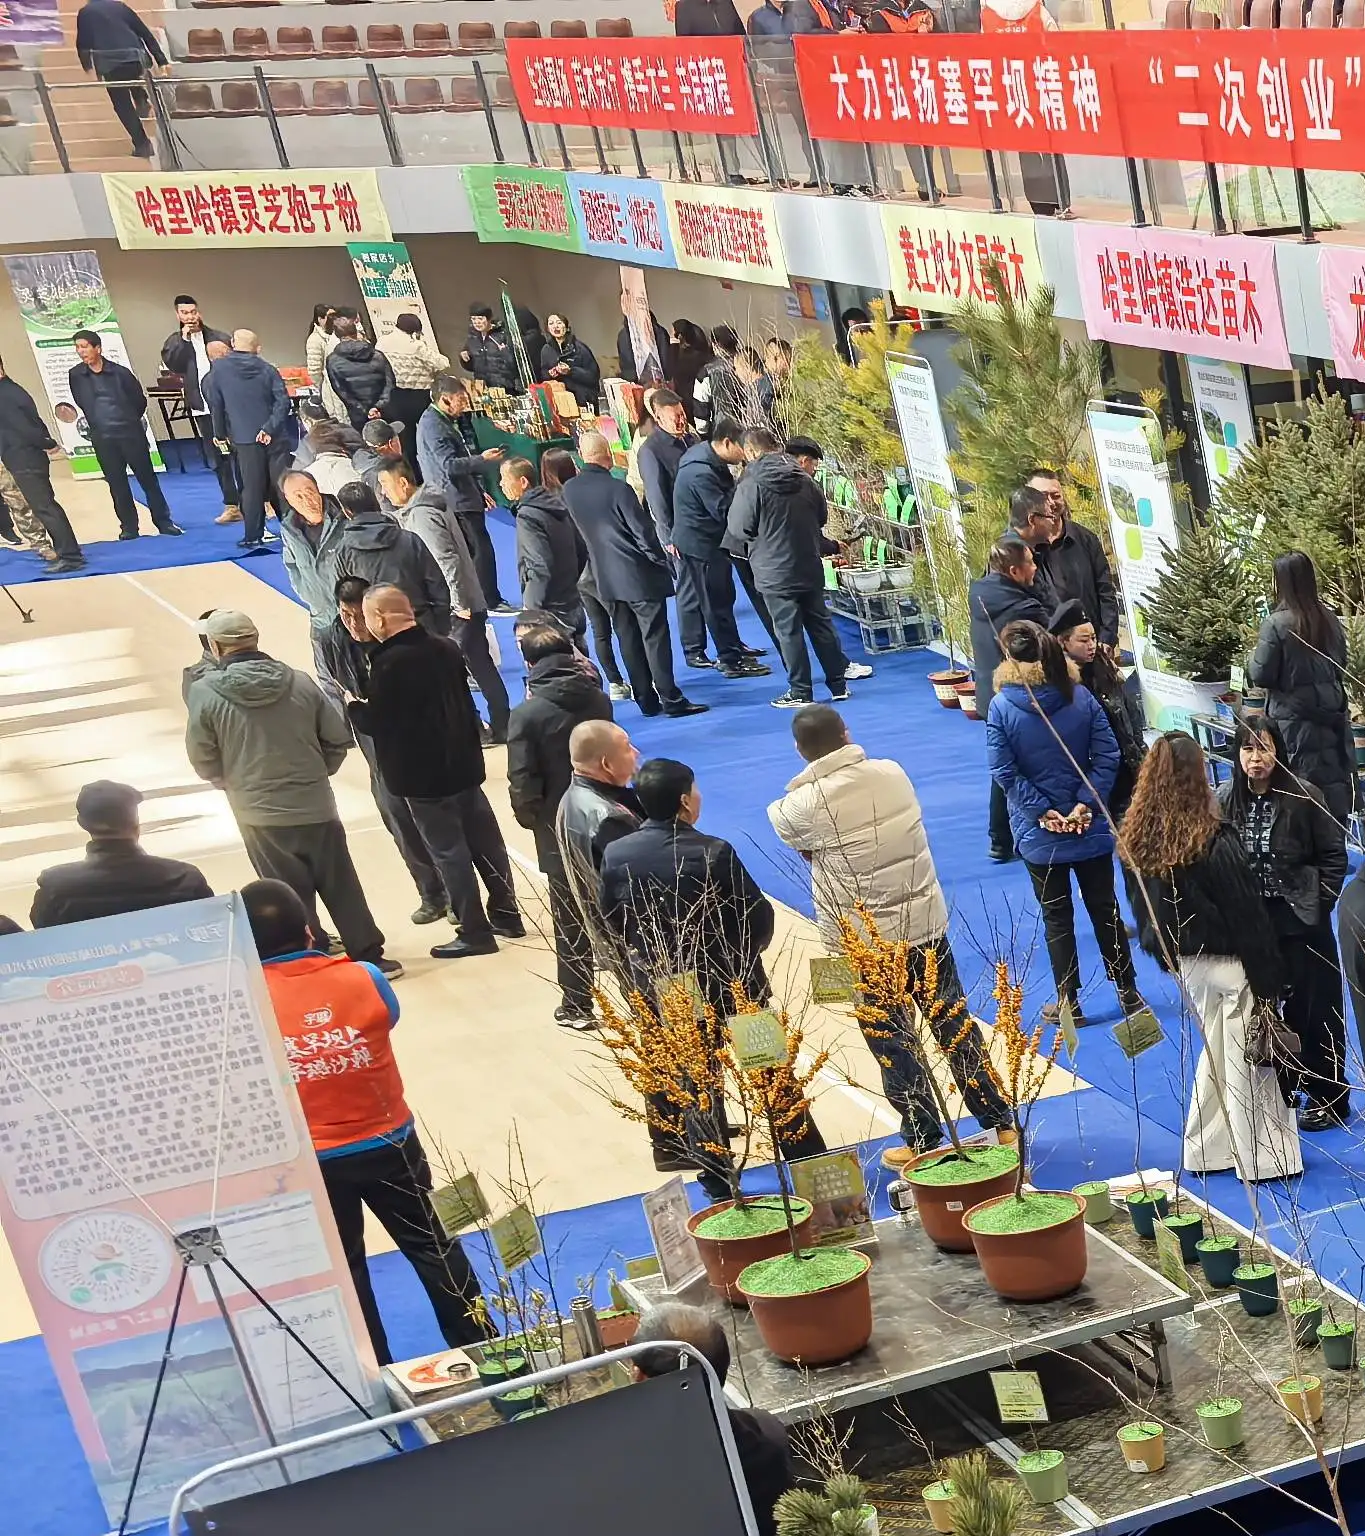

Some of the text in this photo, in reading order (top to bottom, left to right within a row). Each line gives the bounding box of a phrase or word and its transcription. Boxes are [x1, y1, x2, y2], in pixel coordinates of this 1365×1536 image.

[829, 54, 1102, 134] 大力弘扬塞罕坝精神
[135, 180, 363, 238] 哈里哈镇灵芝孢子粉
[1096, 242, 1264, 346] 哈里哈镇浩达苗木
